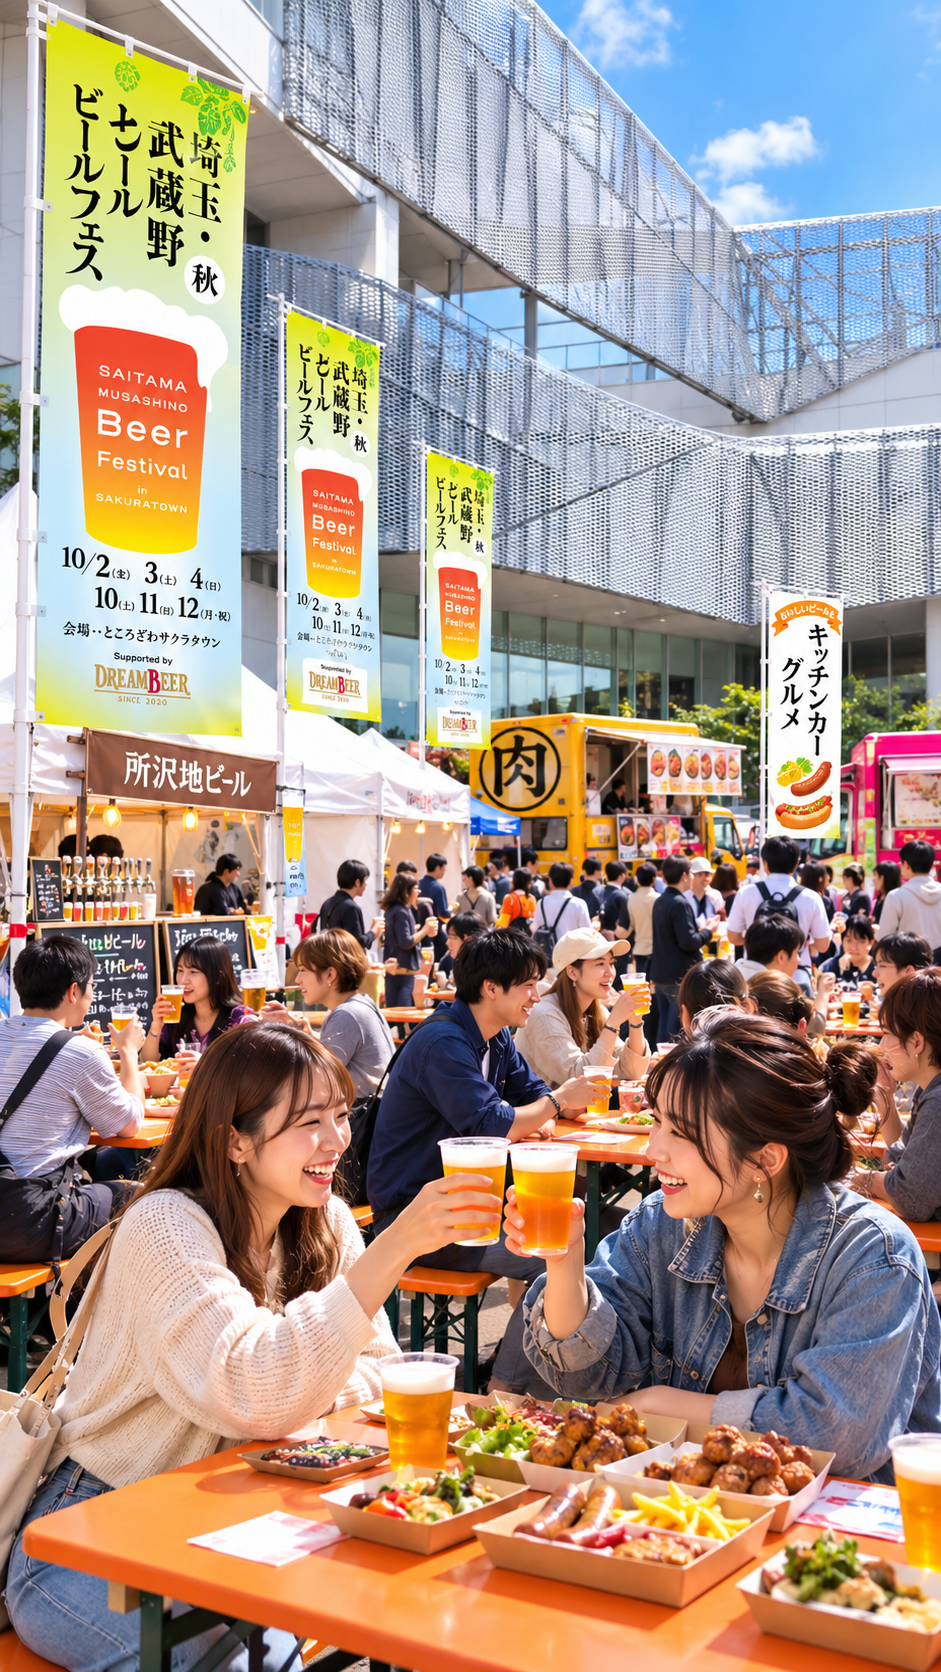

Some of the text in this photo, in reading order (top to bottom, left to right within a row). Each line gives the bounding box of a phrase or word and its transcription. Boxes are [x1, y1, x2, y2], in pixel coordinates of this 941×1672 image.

[64, 84, 106, 281] ビールフェス
[146, 121, 186, 267] 武蔵野
[191, 263, 218, 298] 秋
[99, 365, 187, 393] SAITAMA
[296, 343, 314, 445] ビールフェス
[98, 387, 188, 413] MUSASHINO
[333, 361, 351, 438] 武蔵野
[97, 408, 188, 448] Beer
[97, 450, 188, 480] Festival
[96, 493, 188, 514] SAKURATOWN
[137, 484, 148, 495] in
[312, 489, 354, 506] SAITAMA
[312, 513, 356, 537] Beer
[445, 600, 475, 616] Beer
[113, 652, 173, 666] Supported by
[117, 695, 168, 707] SINCE 2020
[780, 658, 804, 730] グルメ
[808, 624, 829, 756] キッチンカー
[493, 734, 547, 798] 肉
